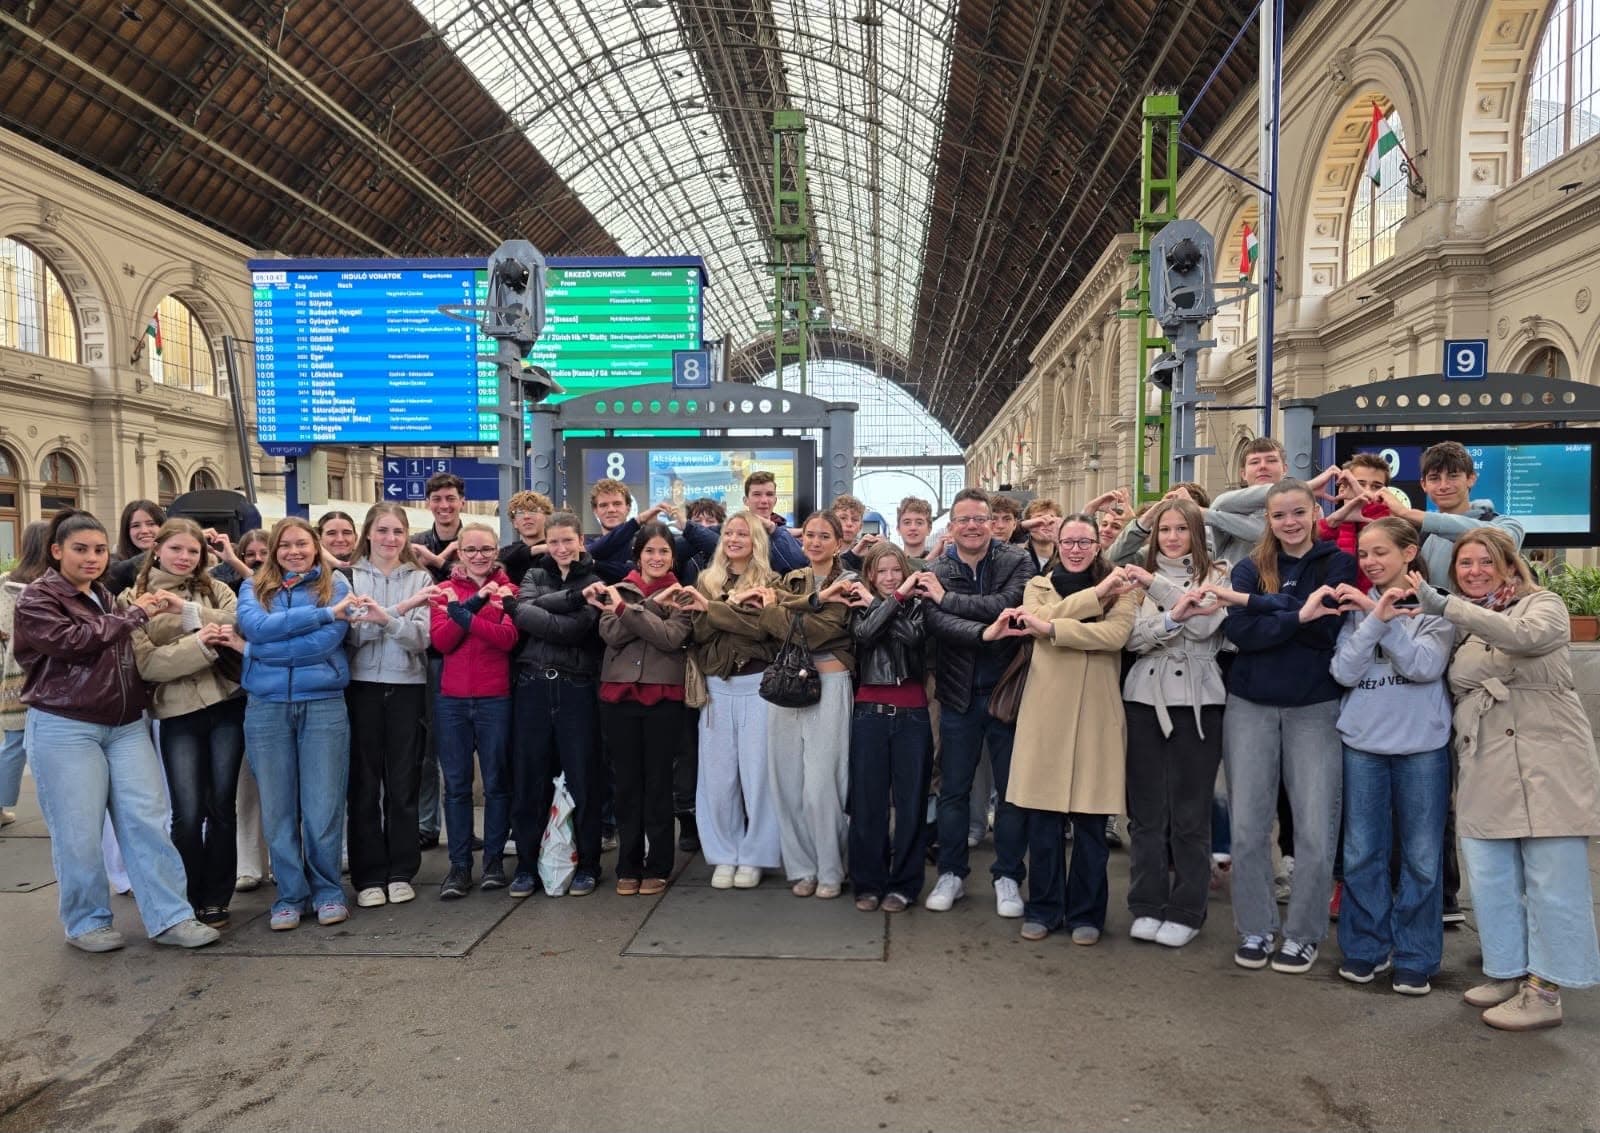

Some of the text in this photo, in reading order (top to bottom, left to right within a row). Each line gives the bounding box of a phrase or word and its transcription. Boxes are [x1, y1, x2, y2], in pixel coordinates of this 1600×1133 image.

[683, 359, 700, 380] 8
[1456, 350, 1476, 372] 9
[411, 462, 418, 472] 1
[438, 462, 446, 472] 5
[606, 452, 625, 481] 8
[1380, 448, 1400, 478] 9
[682, 485, 700, 495] the
